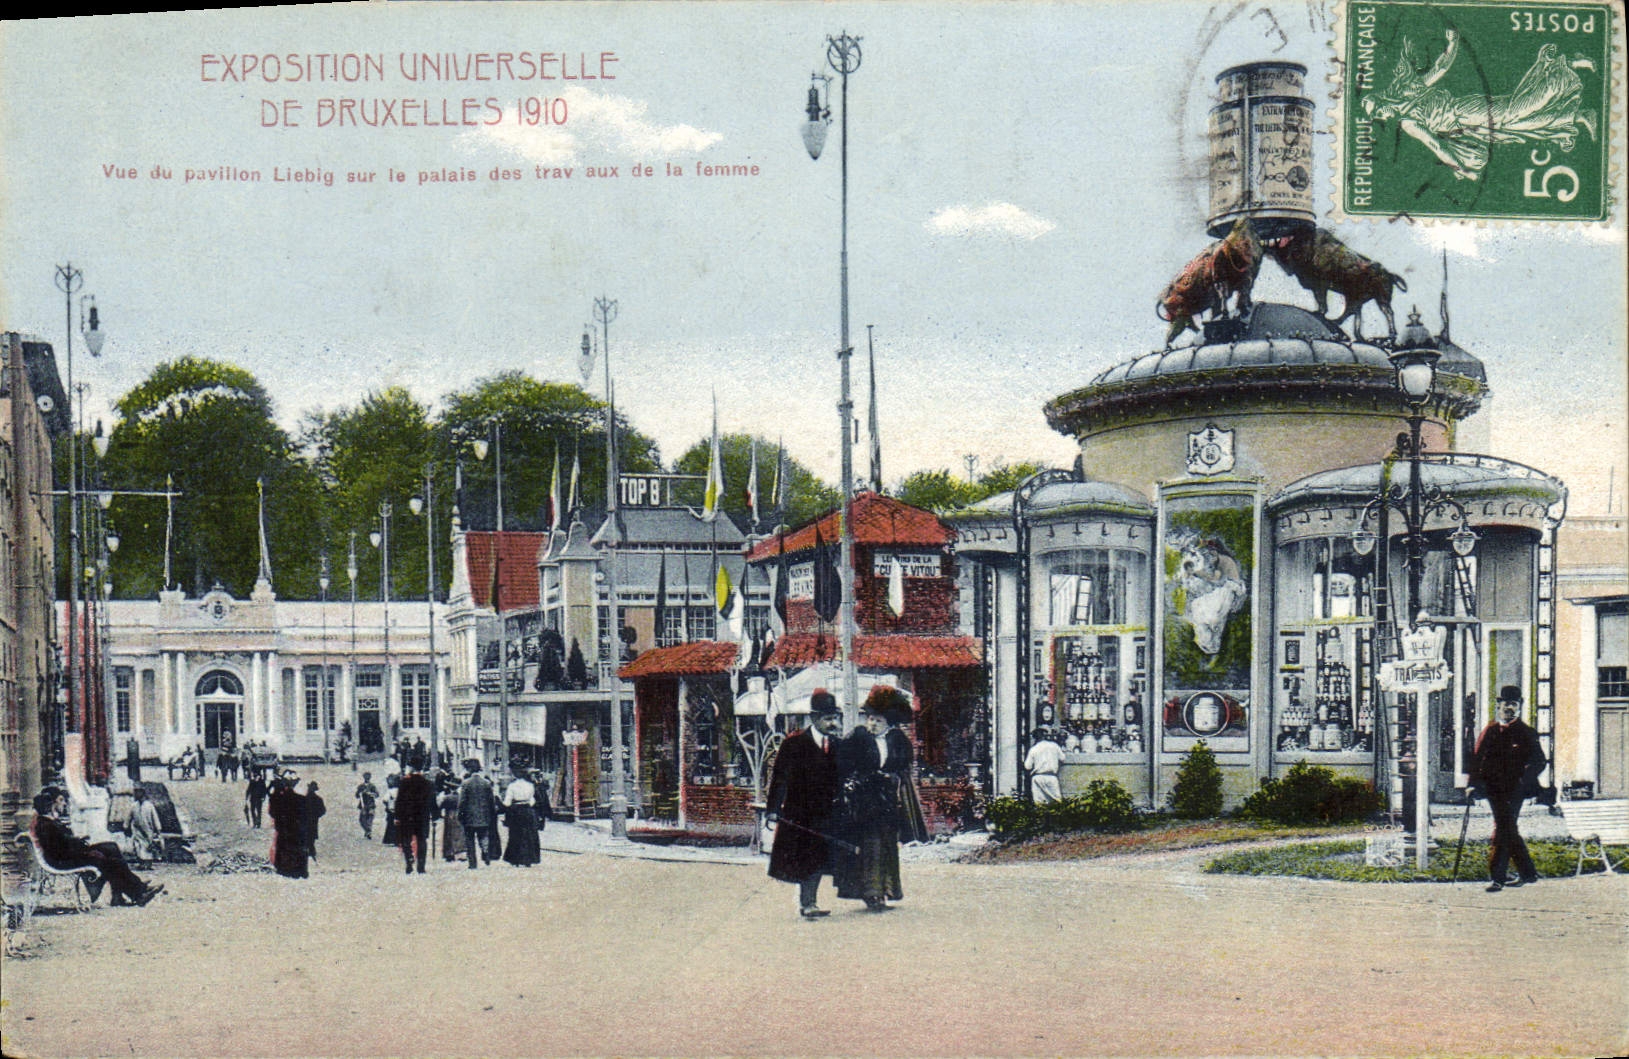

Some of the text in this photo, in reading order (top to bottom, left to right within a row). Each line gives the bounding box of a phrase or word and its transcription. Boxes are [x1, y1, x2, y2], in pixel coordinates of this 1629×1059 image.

[1510, 11, 1595, 33] POSTES
[620, 478, 648, 505] TOP
[922, 556, 933, 564] LA
